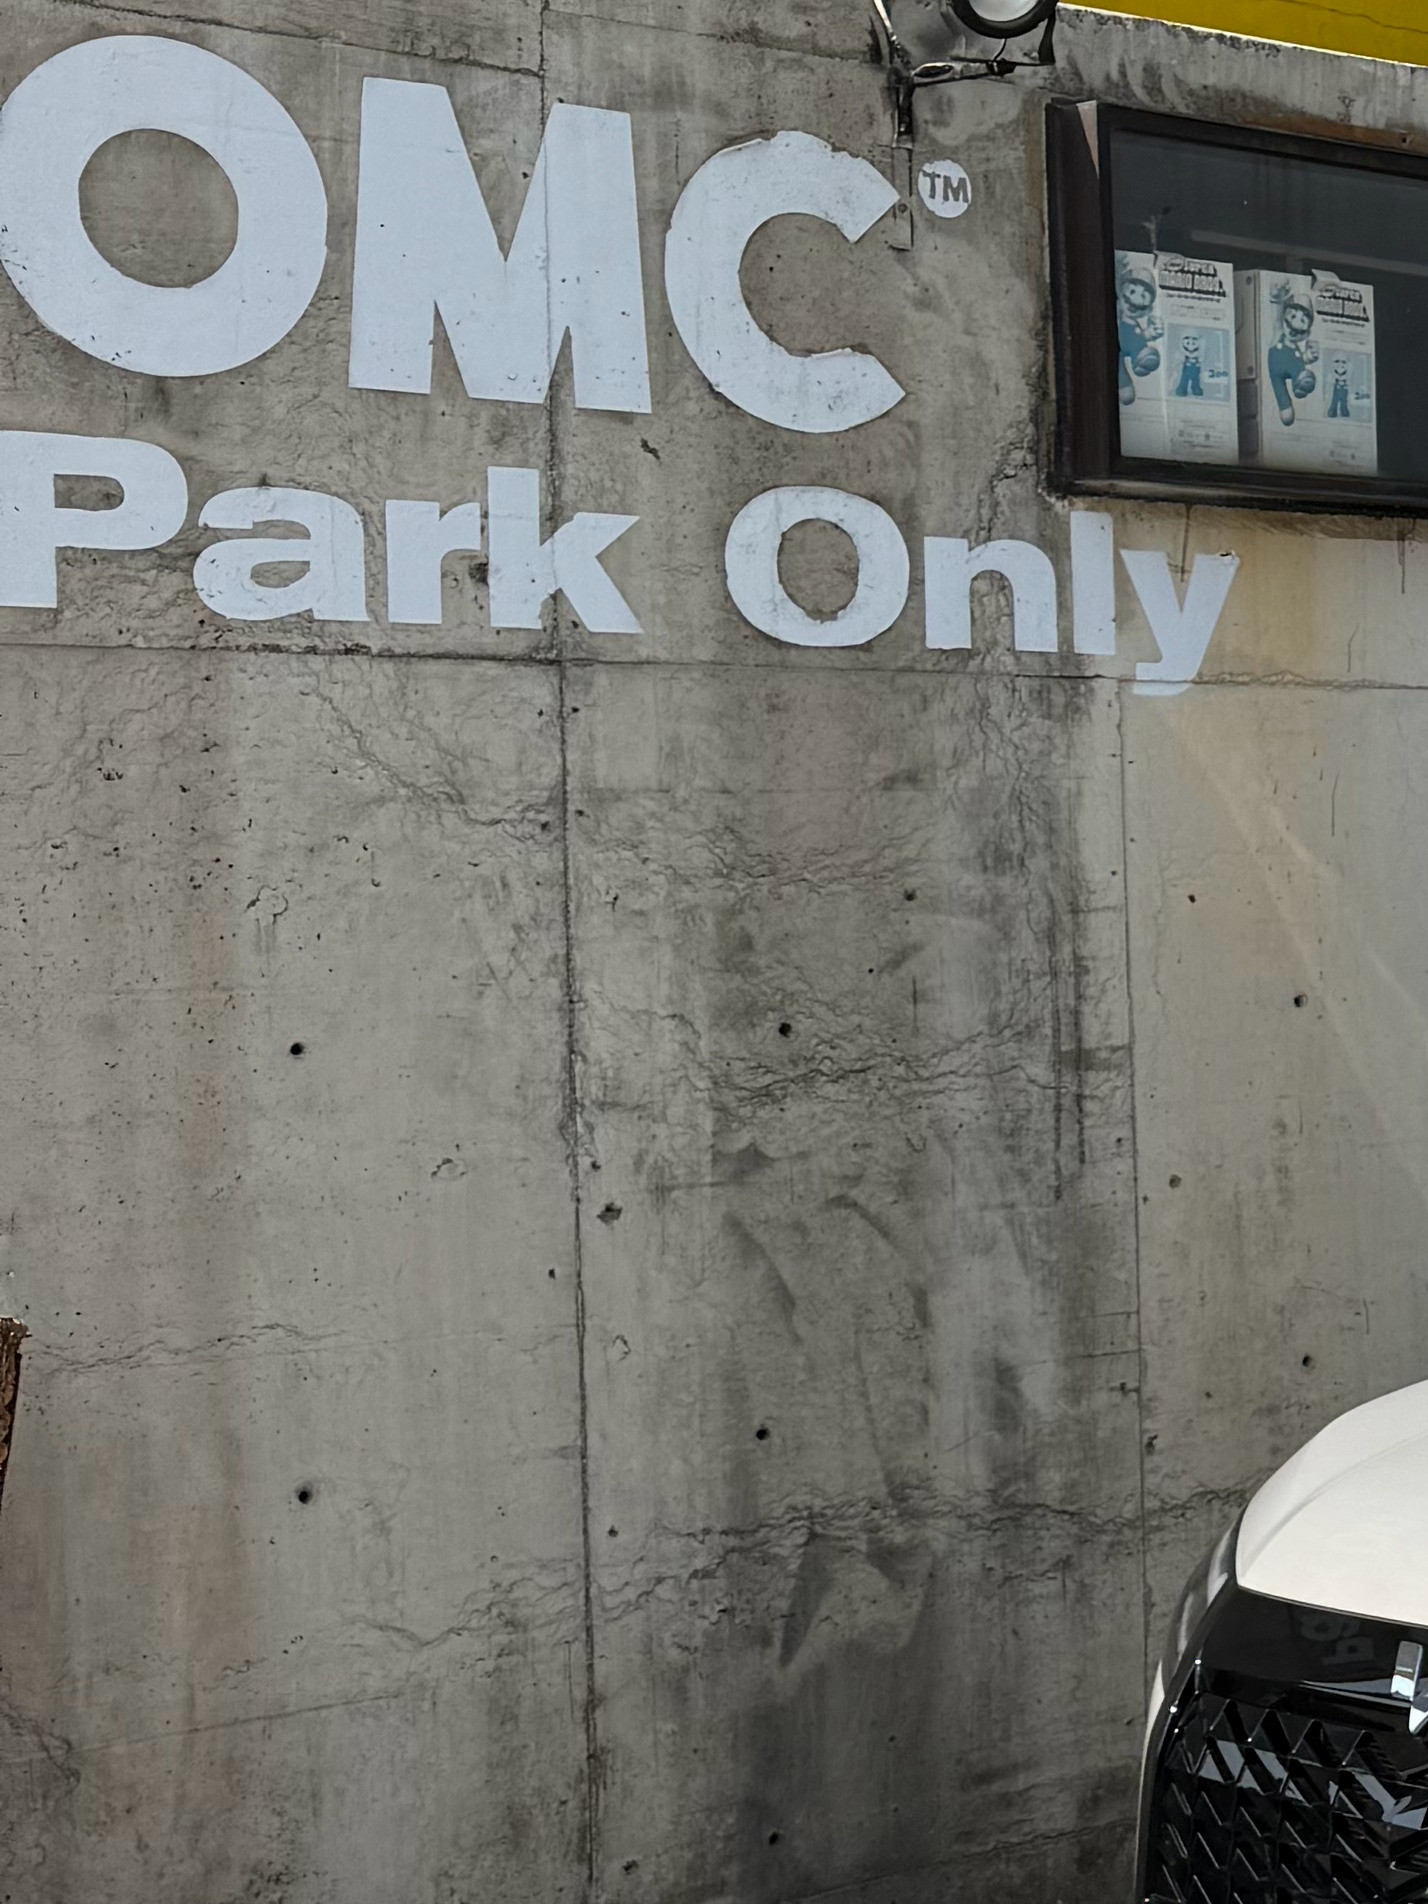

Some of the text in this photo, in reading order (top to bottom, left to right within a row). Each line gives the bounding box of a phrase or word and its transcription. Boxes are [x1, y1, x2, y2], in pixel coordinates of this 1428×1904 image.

[0, 34, 906, 434] OMC
[0, 430, 1241, 699] Park Only
